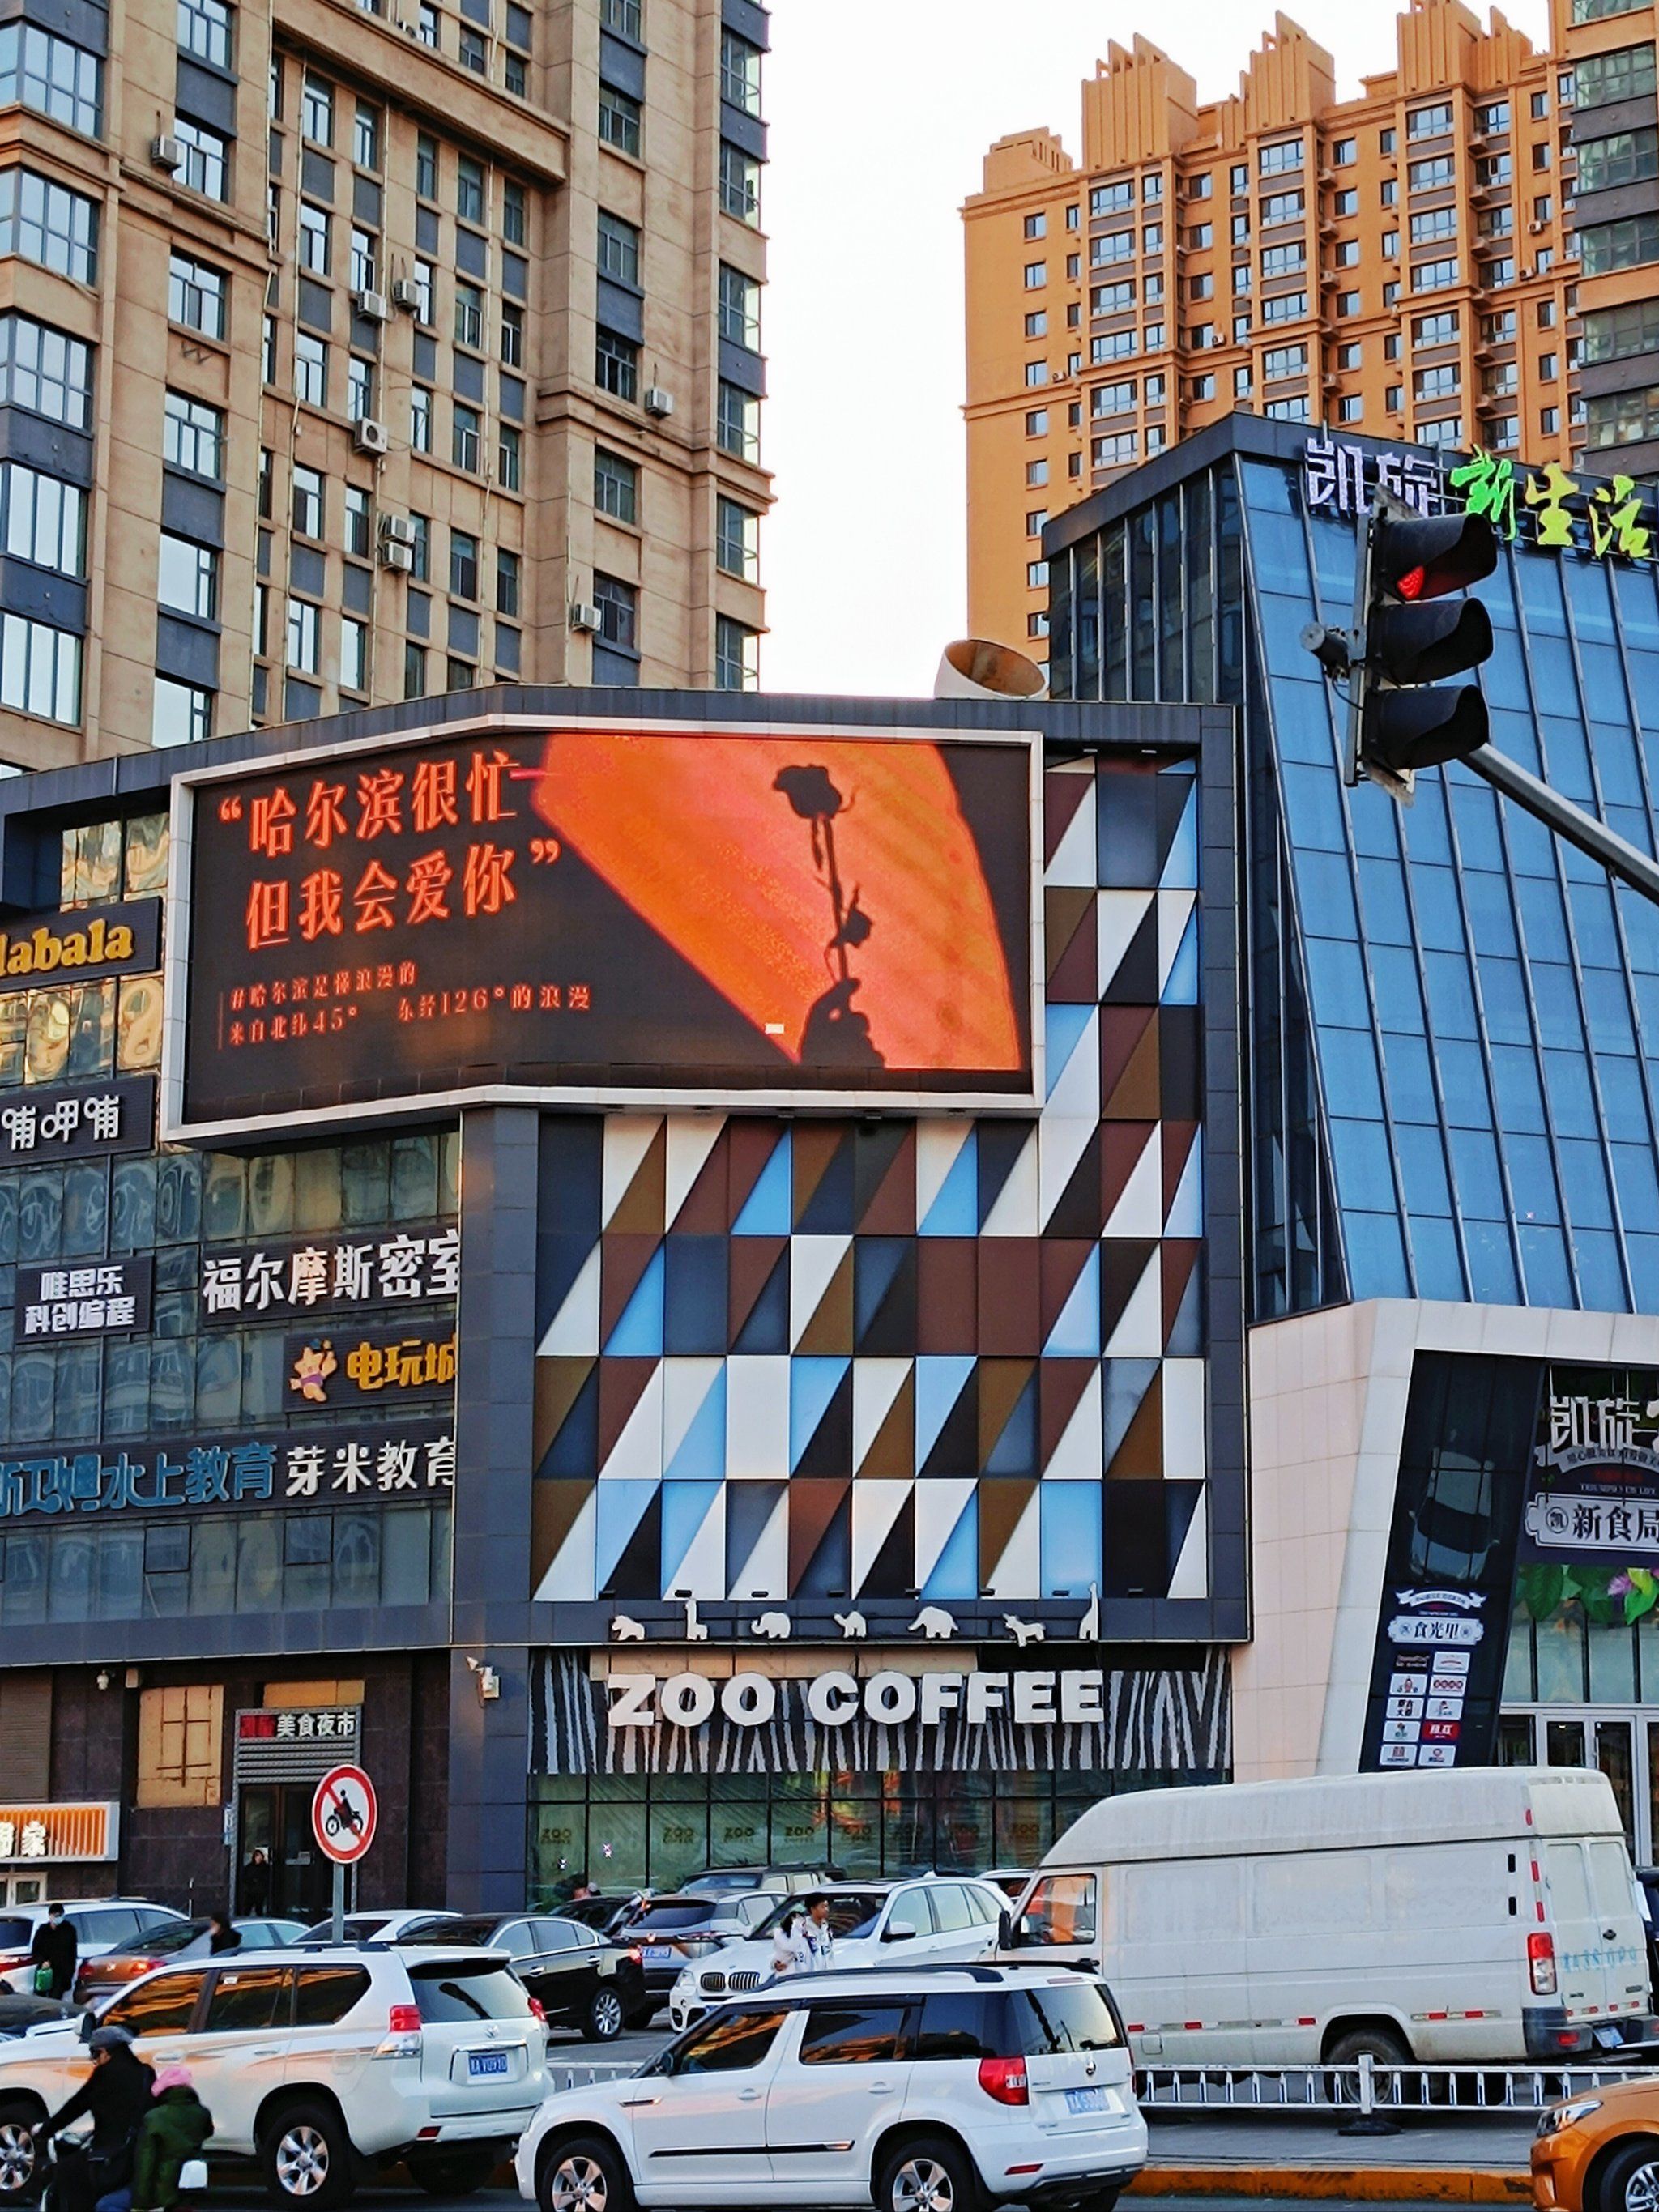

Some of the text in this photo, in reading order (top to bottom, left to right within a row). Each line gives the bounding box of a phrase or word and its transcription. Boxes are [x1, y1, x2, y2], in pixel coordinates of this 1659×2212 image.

[203, 1229, 460, 1314] 福尔摩斯密室
[1550, 1395, 1659, 1451] 凯旋
[286, 1436, 456, 1498] 芽米教育
[277, 1712, 355, 1738] 美食夜市
[607, 1669, 1105, 1728] ZOO COFFEE
